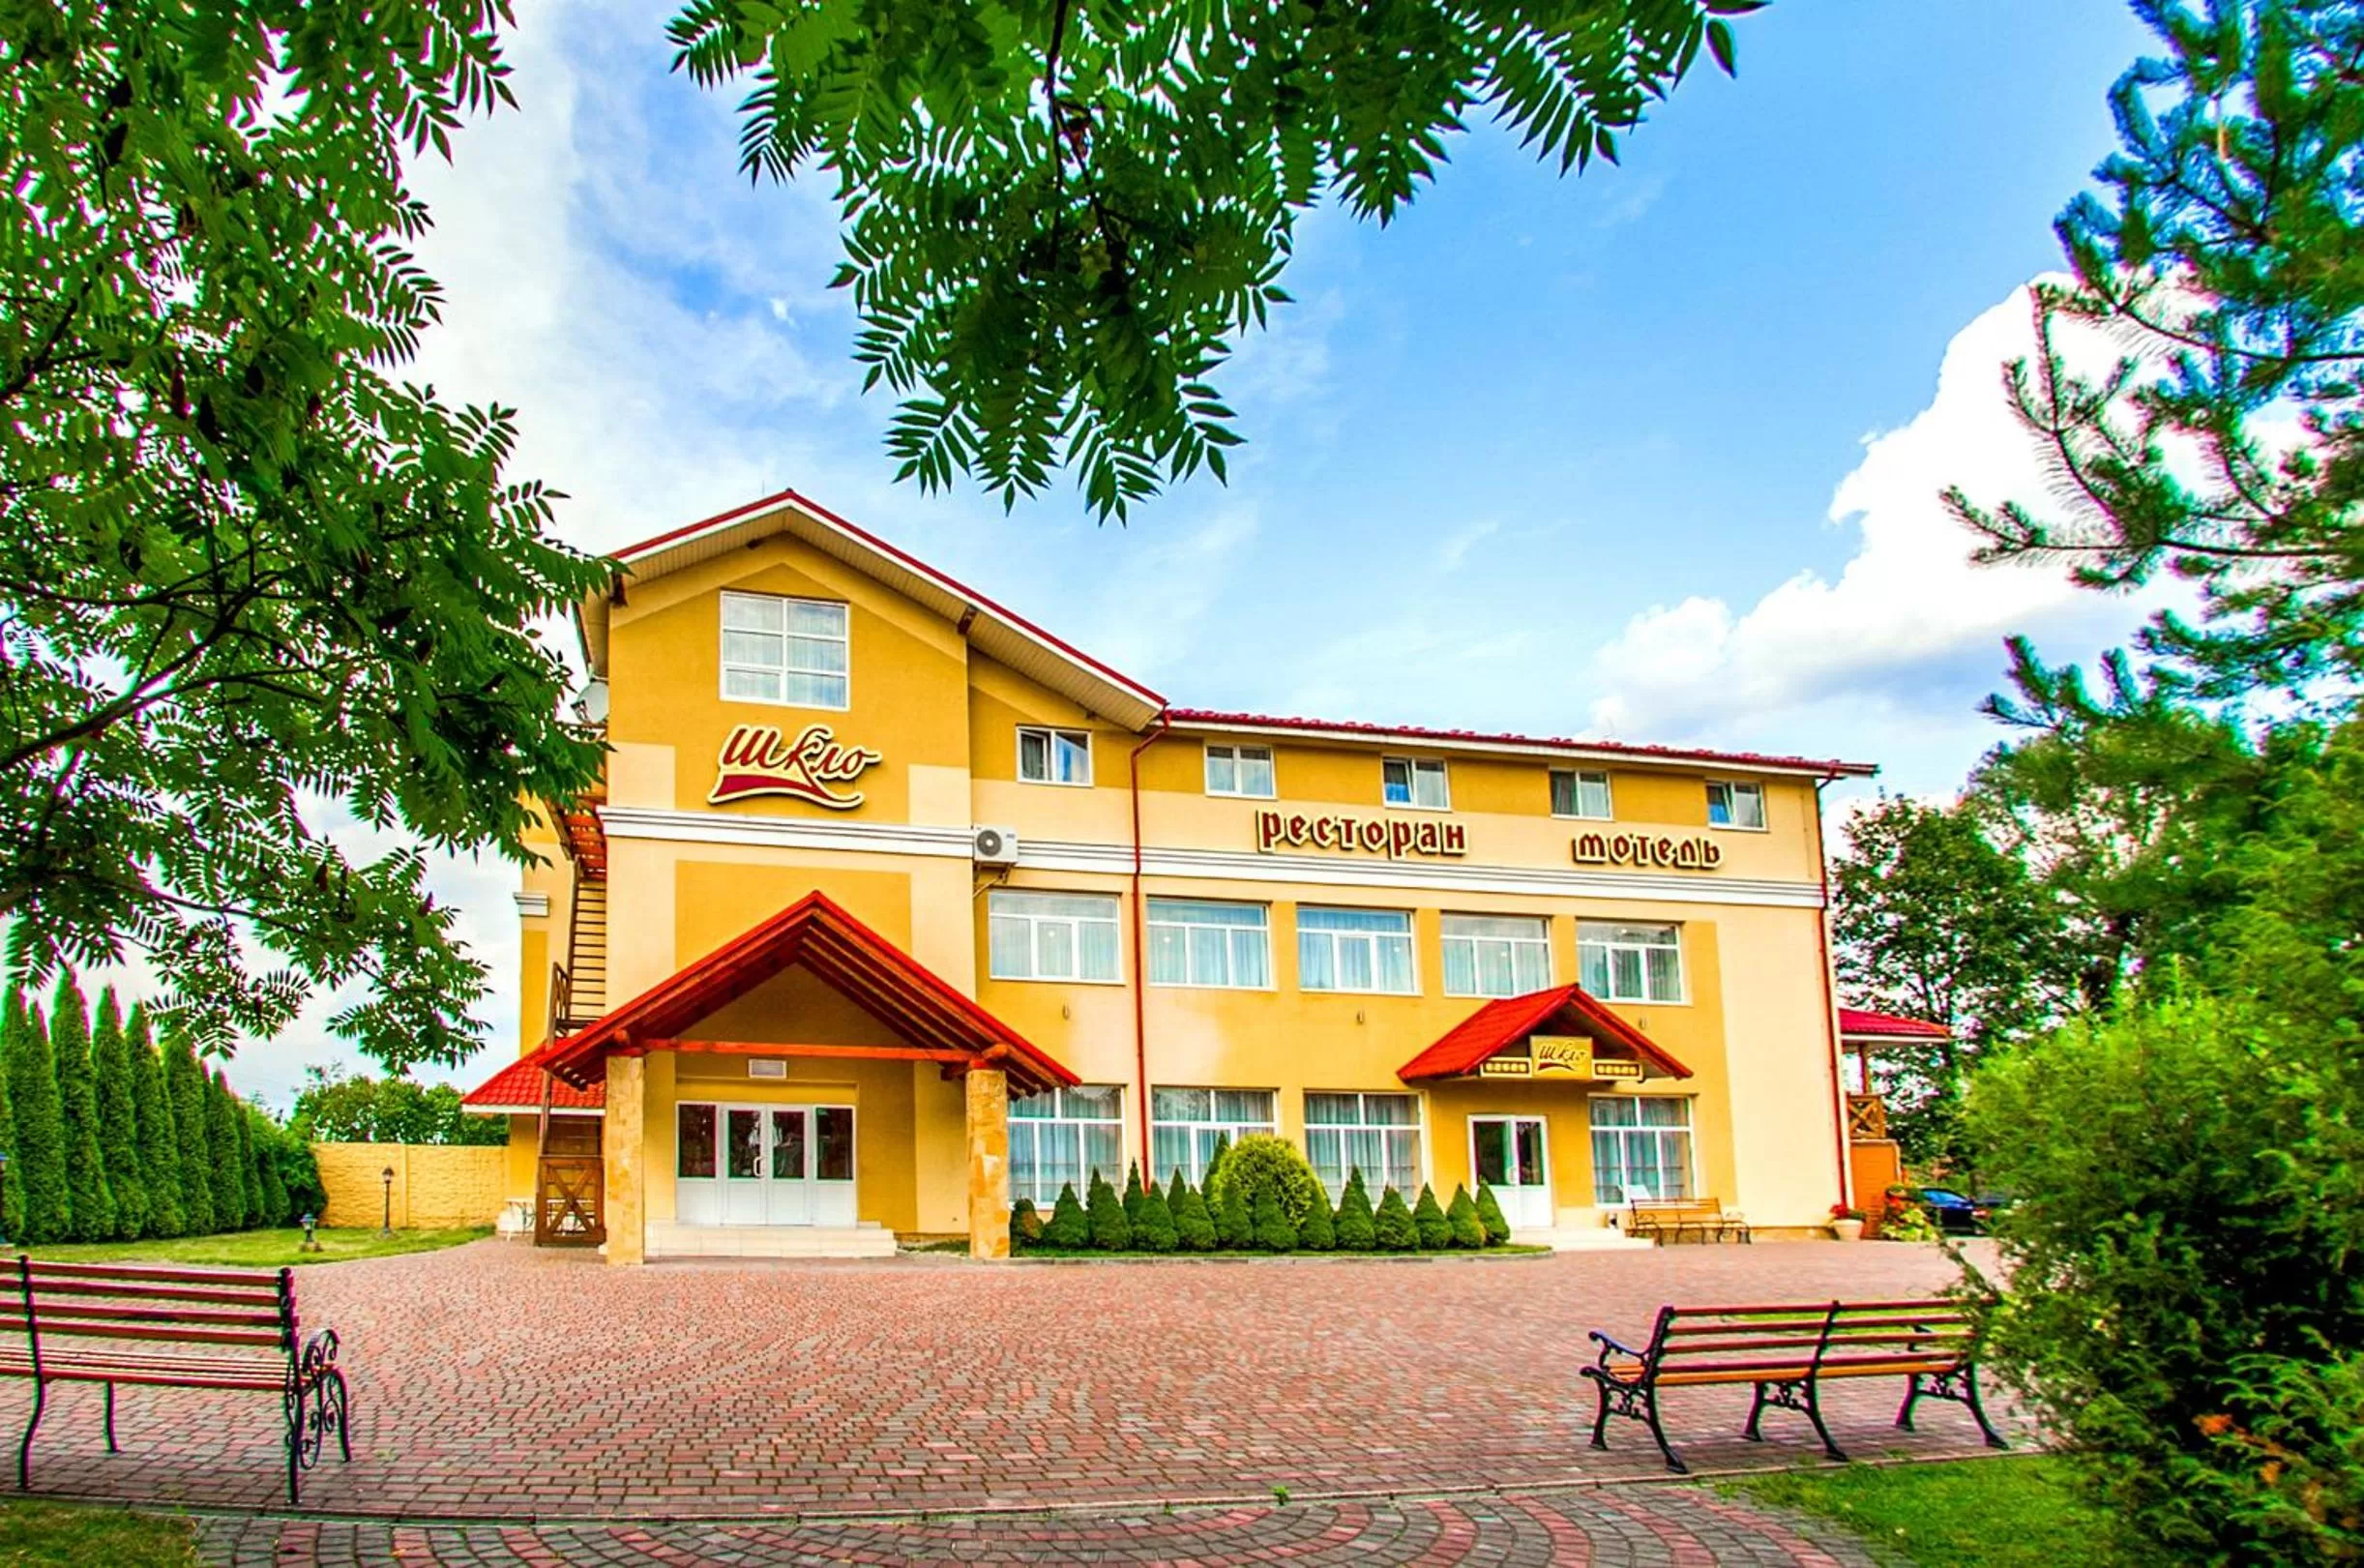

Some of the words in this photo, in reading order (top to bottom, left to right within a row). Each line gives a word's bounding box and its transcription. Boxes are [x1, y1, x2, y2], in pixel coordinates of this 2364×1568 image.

[720, 725, 880, 802] Шкло
[1259, 810, 1466, 858] ресторан
[1576, 832, 1722, 867] мотель
